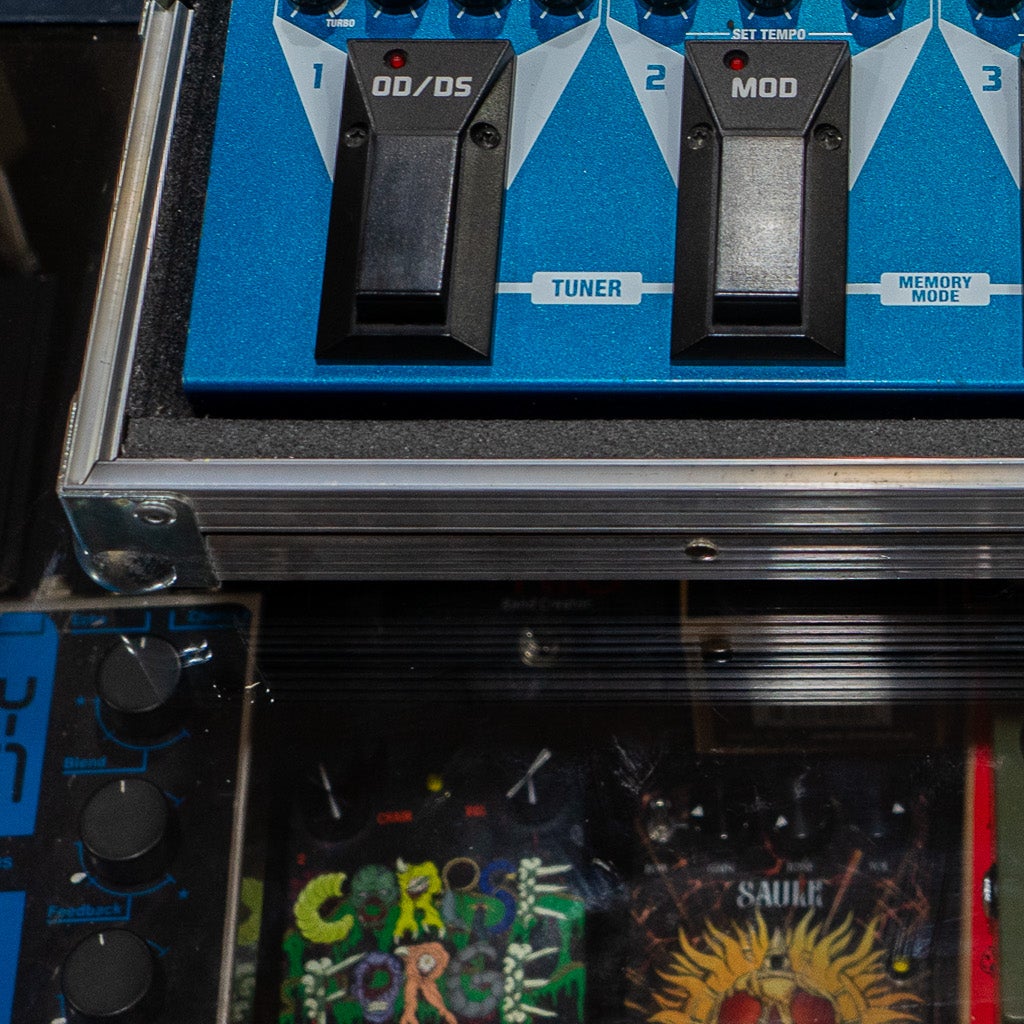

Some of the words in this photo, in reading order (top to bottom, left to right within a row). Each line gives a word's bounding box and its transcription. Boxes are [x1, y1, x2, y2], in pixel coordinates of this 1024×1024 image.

[326, 19, 355, 28] TURBO
[733, 29, 759, 40] SET
[761, 29, 806, 40] TEMPO
[313, 63, 323, 89] 1
[645, 65, 666, 90] 2
[981, 66, 1001, 91] 3
[371, 76, 473, 97] OD/DS
[732, 77, 798, 98] MOD
[552, 279, 621, 297] TUNER
[899, 275, 972, 289] MEMORY
[912, 290, 960, 302] MODE
[64, 756, 107, 770] Blend
